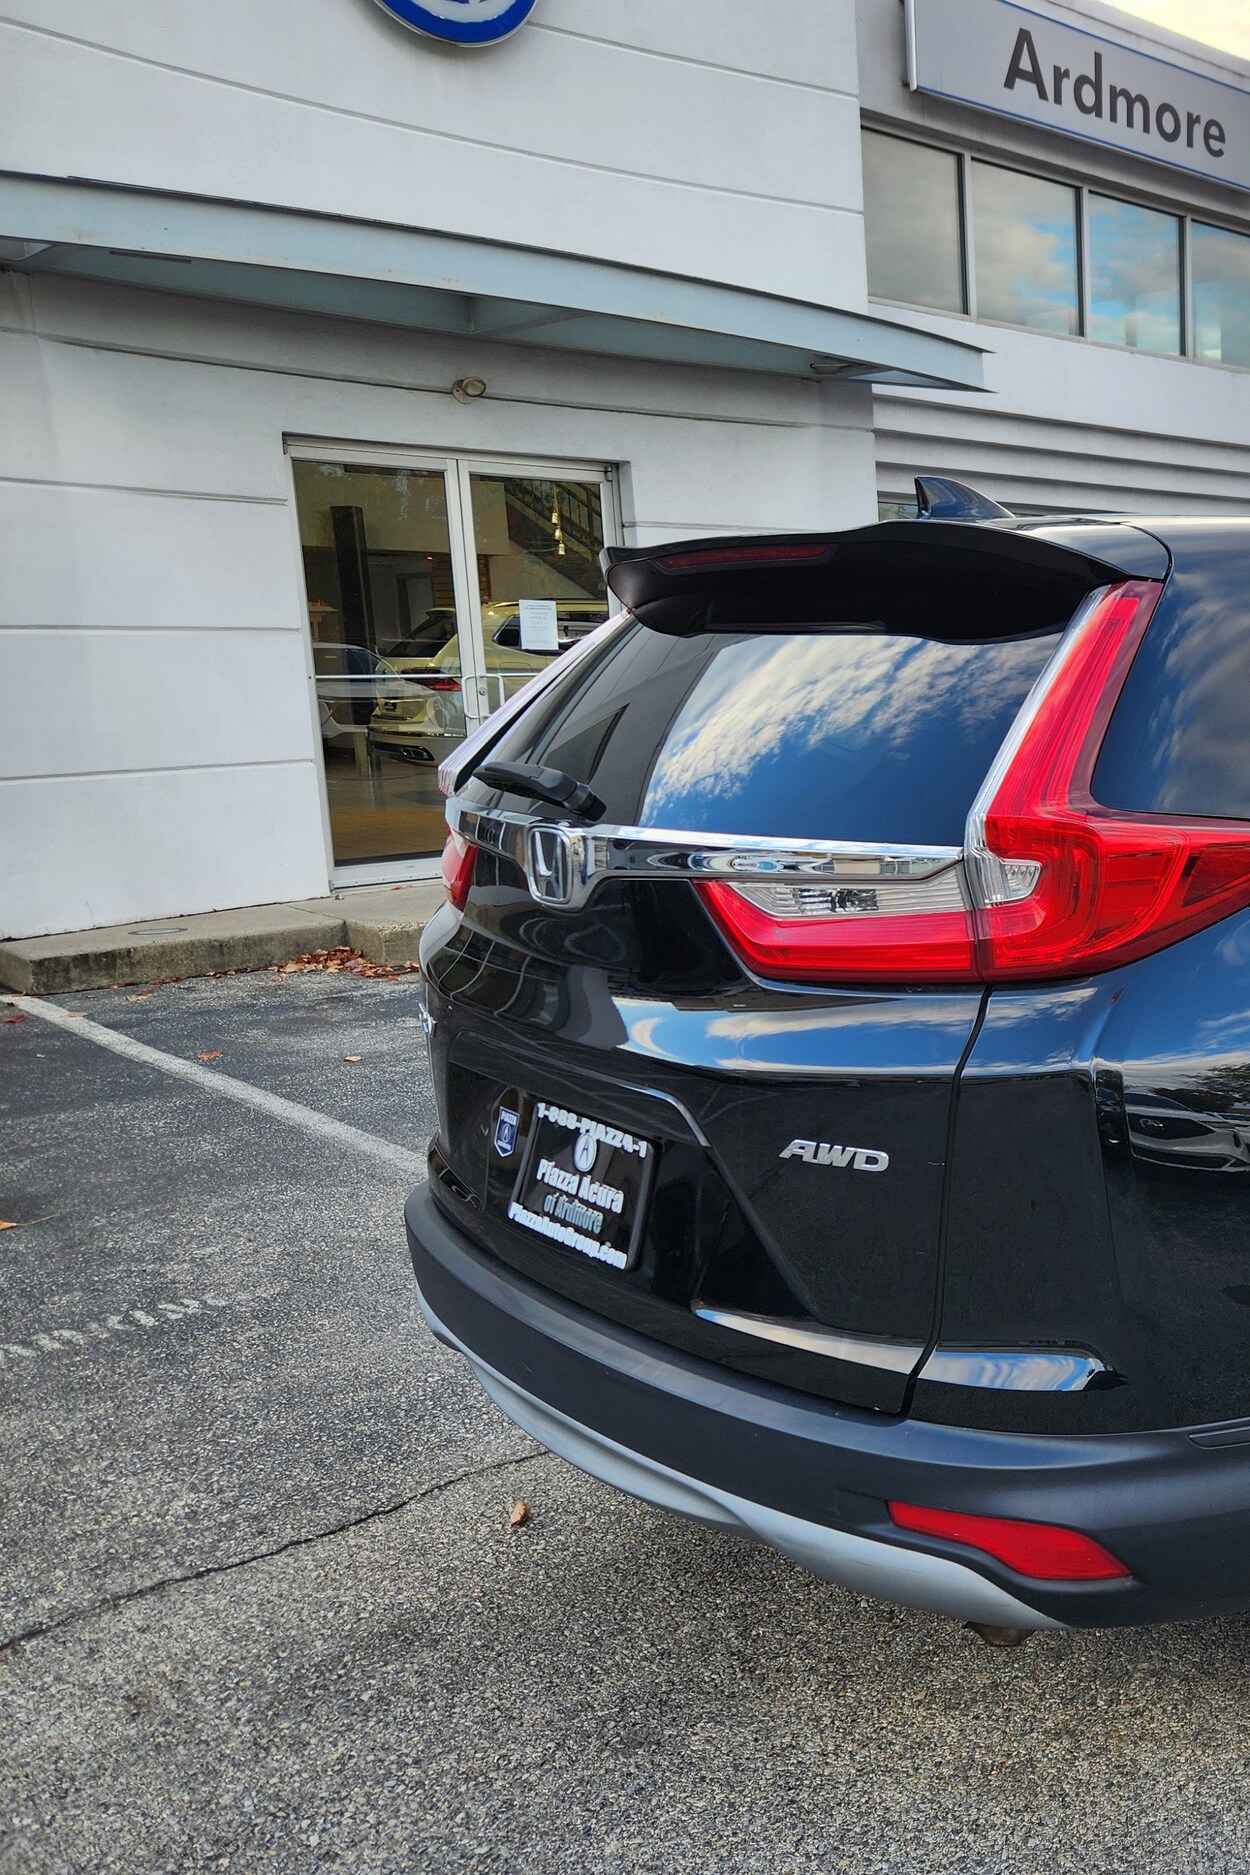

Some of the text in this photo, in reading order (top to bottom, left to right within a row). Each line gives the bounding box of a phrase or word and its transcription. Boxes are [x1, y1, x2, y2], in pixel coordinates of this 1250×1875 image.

[1003, 27, 1226, 158] Ardmore
[779, 1139, 889, 1172] AWD
[536, 1158, 624, 1213] Piazza Acura
